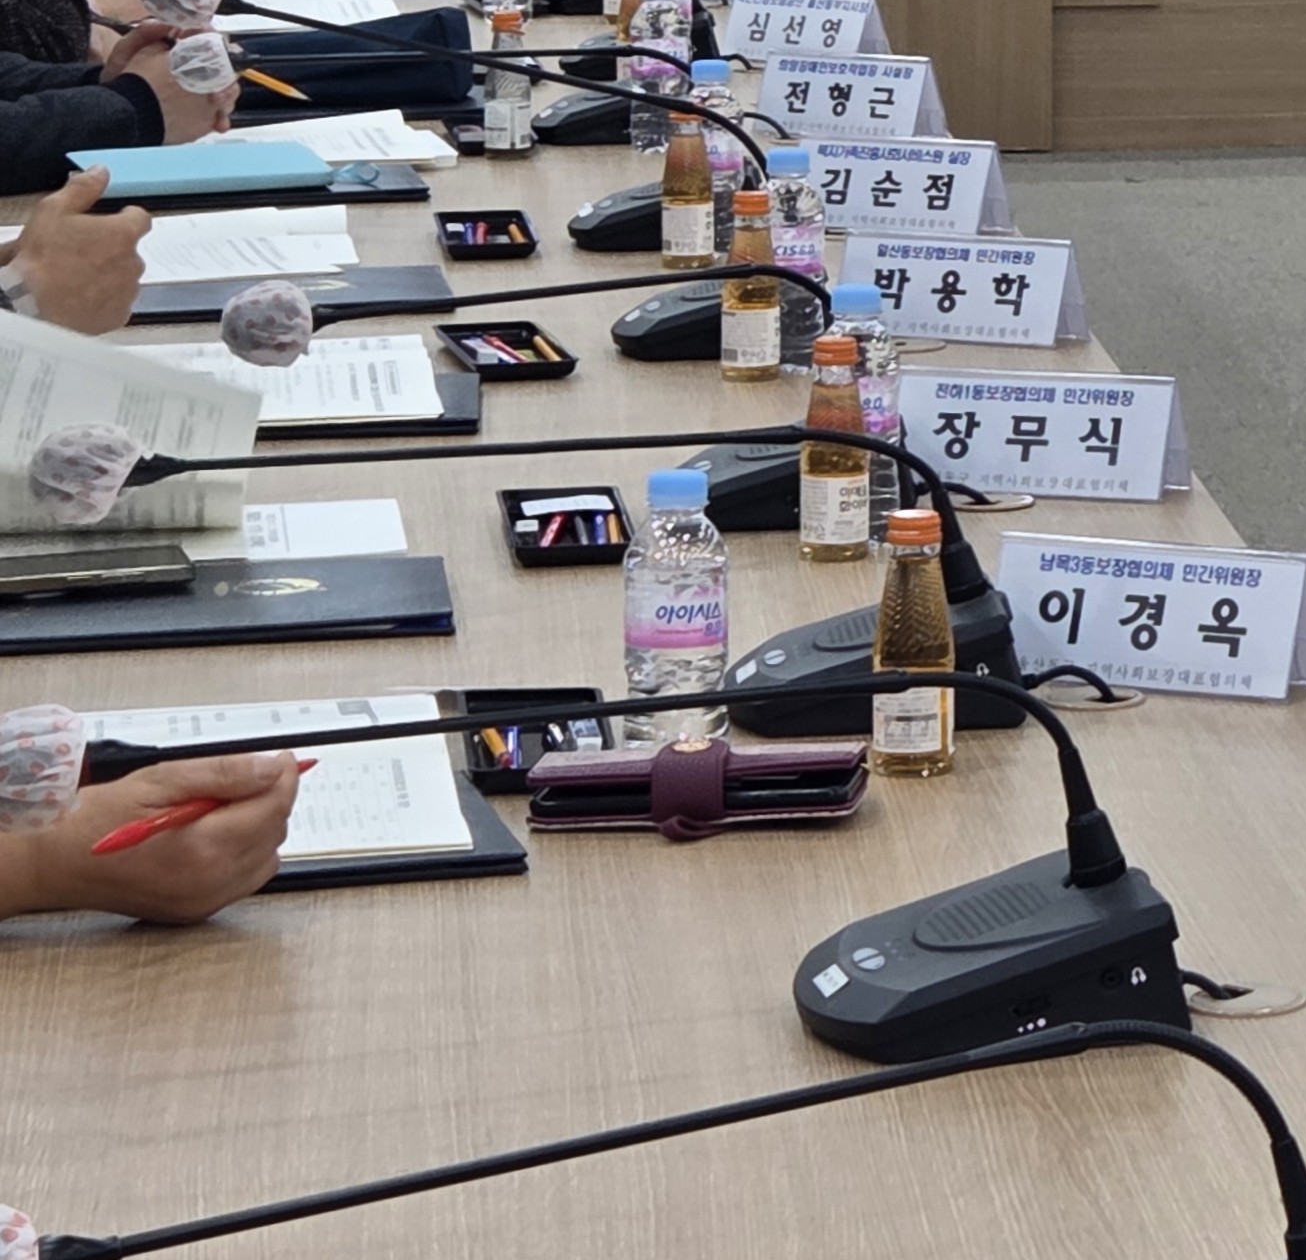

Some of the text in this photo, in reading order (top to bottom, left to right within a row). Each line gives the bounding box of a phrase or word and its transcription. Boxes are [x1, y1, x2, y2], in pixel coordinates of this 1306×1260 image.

[976, 249, 1036, 266] 민간위원장
[1063, 387, 1135, 407] 민간위원장
[1040, 552, 1262, 588] 남목3동보장협의체 민간위원장
